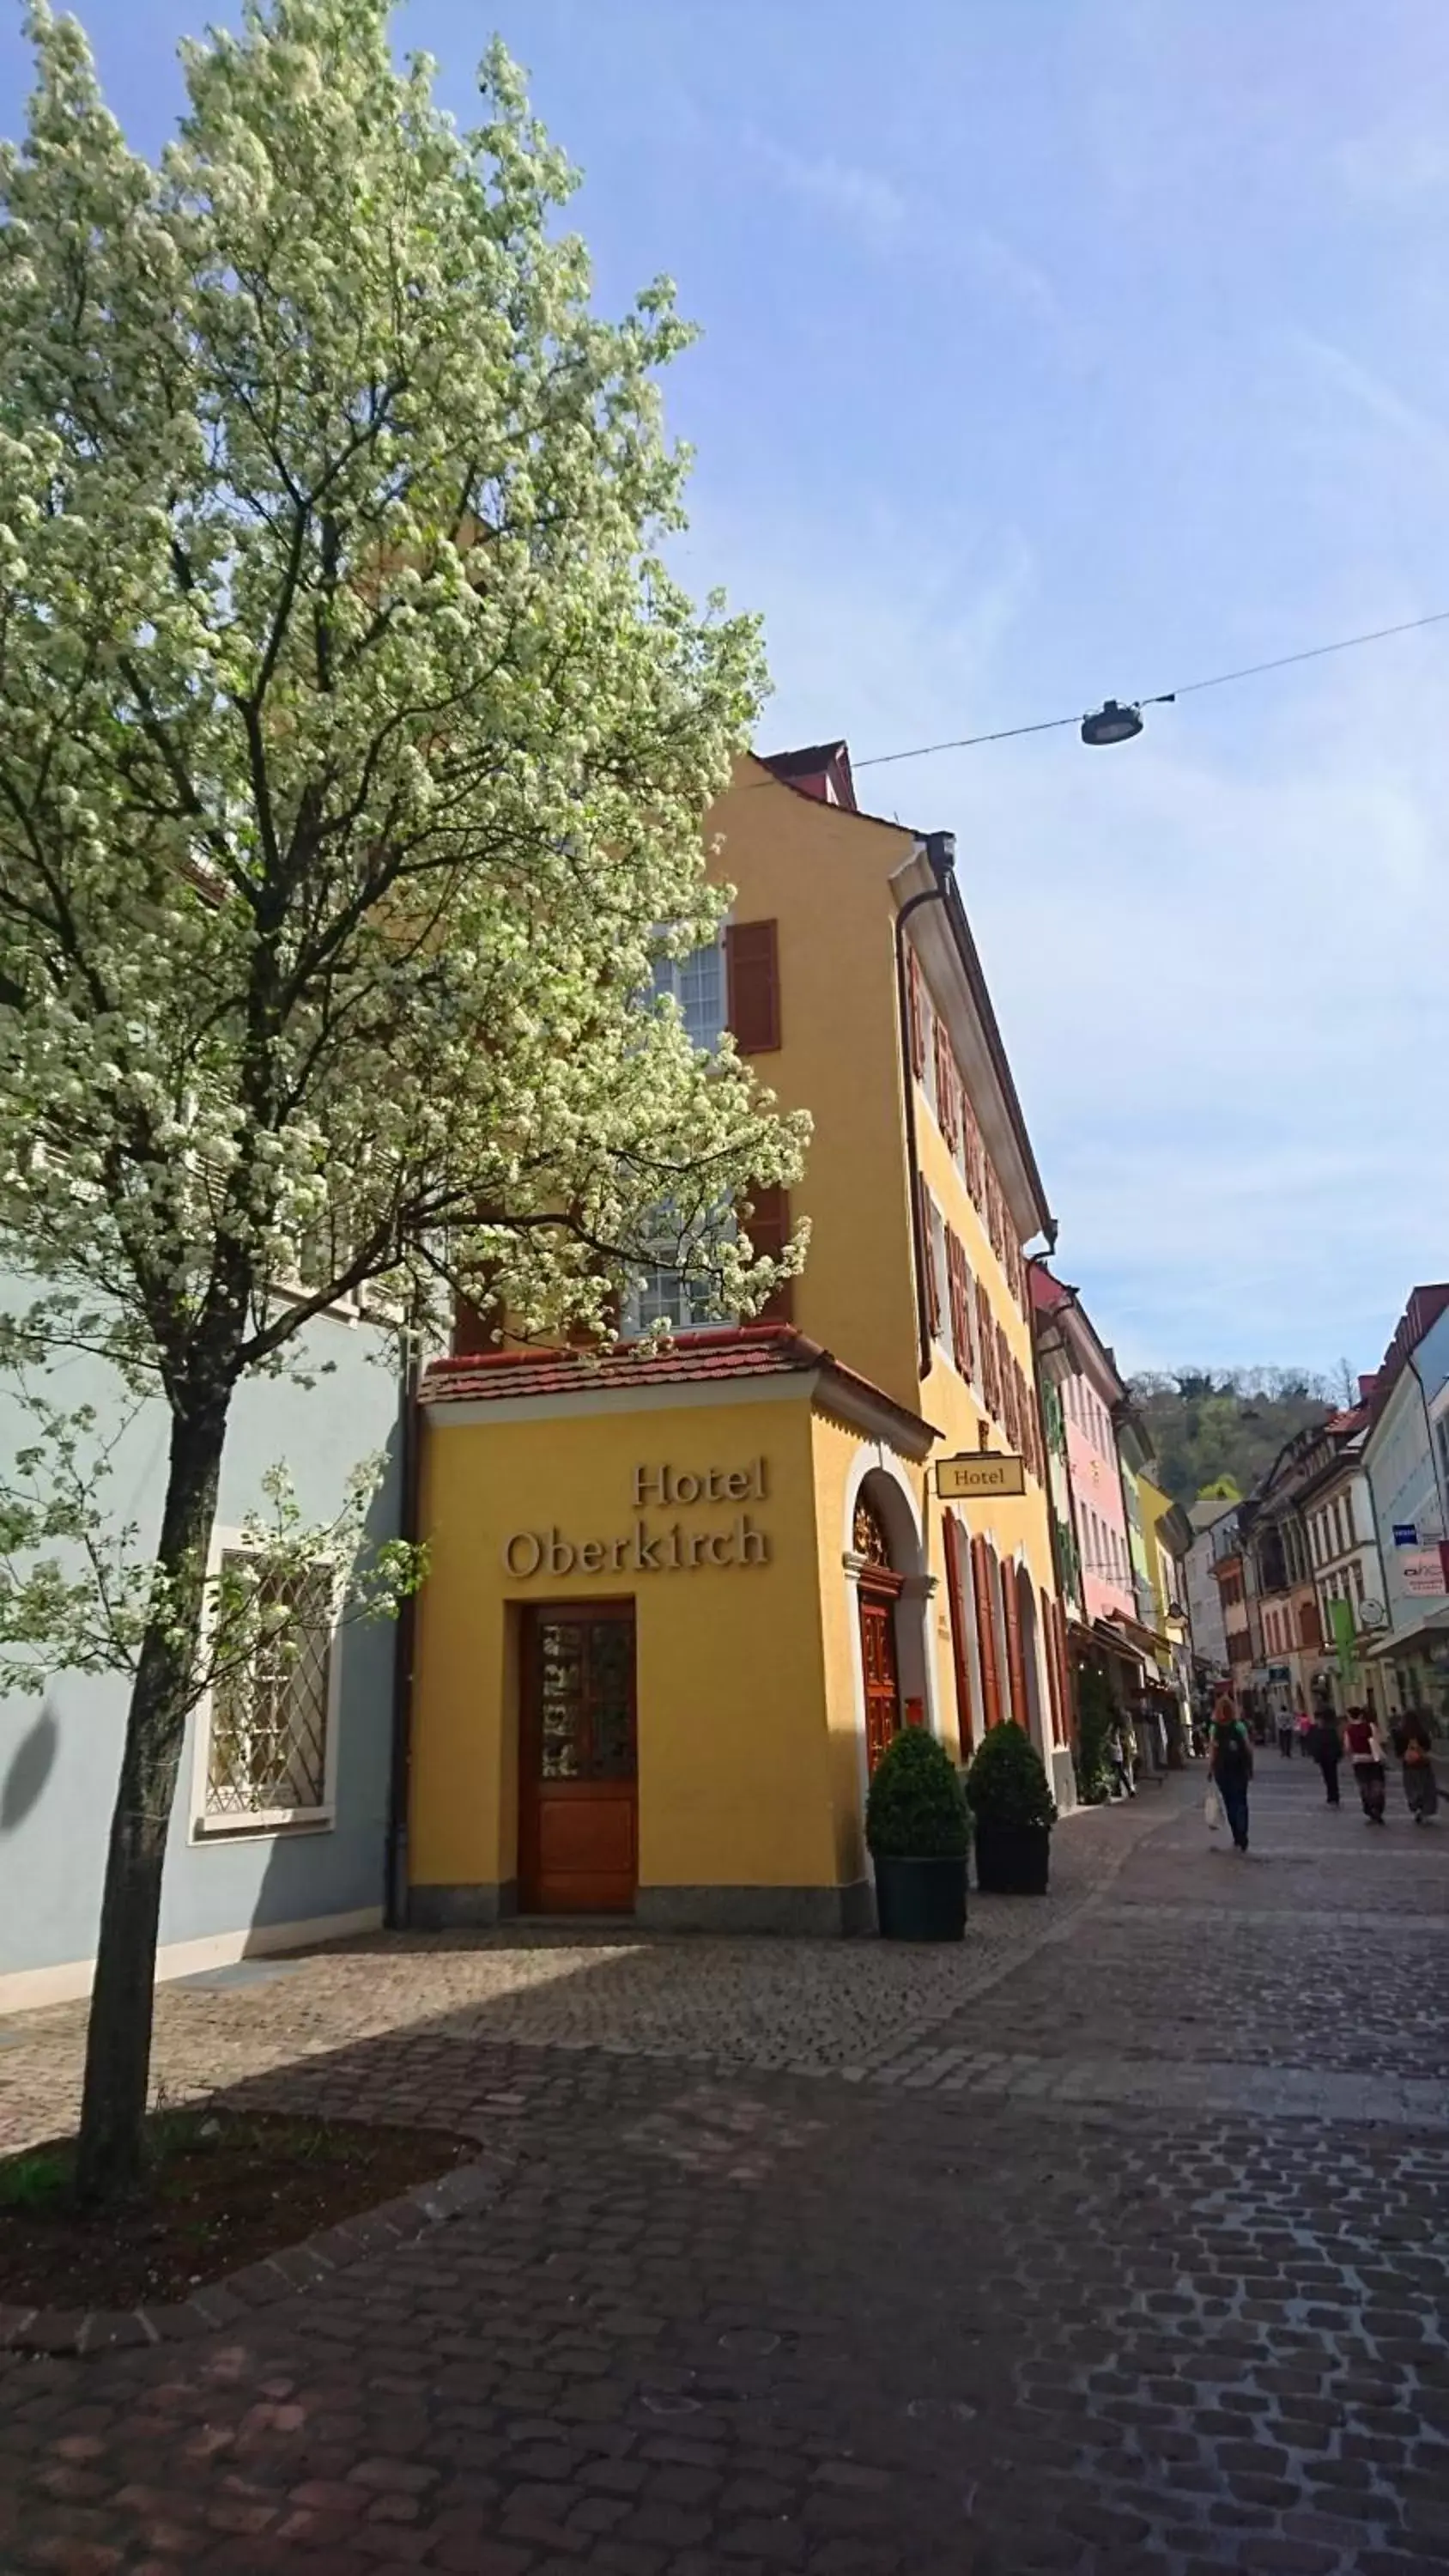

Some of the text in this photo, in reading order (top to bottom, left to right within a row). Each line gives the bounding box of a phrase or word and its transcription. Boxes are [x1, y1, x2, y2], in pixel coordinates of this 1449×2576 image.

[633, 1456, 768, 1506] Hotel
[955, 1468, 1004, 1485] Hotel
[504, 1515, 769, 1578] Oberkirch
